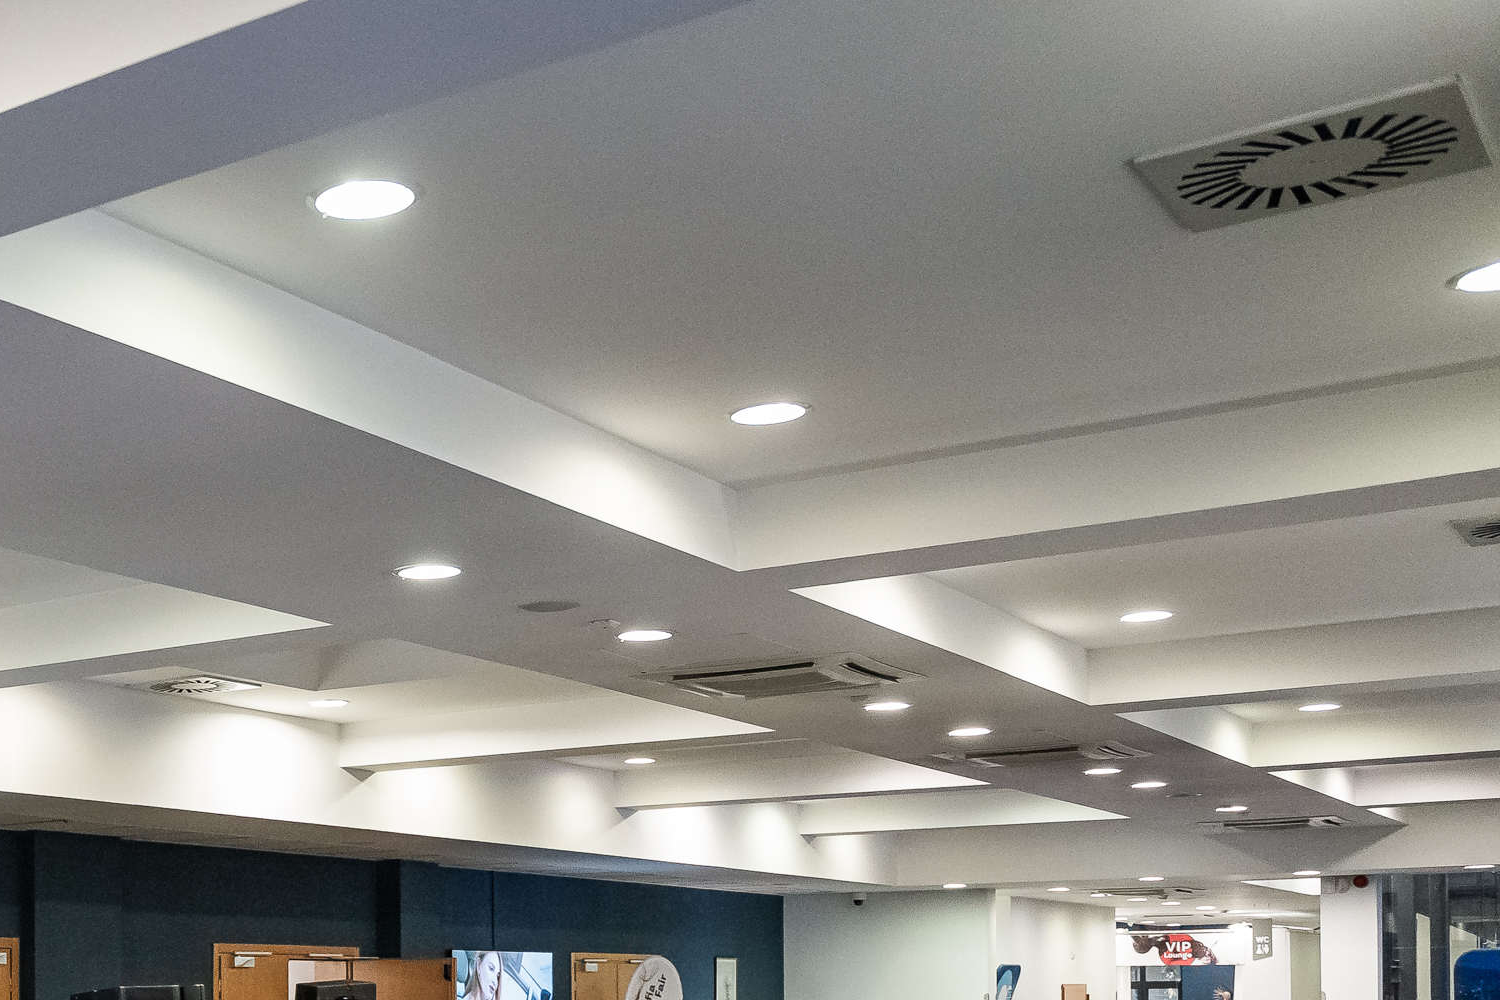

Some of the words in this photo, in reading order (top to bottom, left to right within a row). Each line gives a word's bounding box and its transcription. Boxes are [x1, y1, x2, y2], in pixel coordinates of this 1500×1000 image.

[1255, 936, 1270, 944] WC
[1165, 941, 1192, 953] VIP
[1163, 952, 1193, 961] Lounge
[654, 974, 667, 998] Fair
